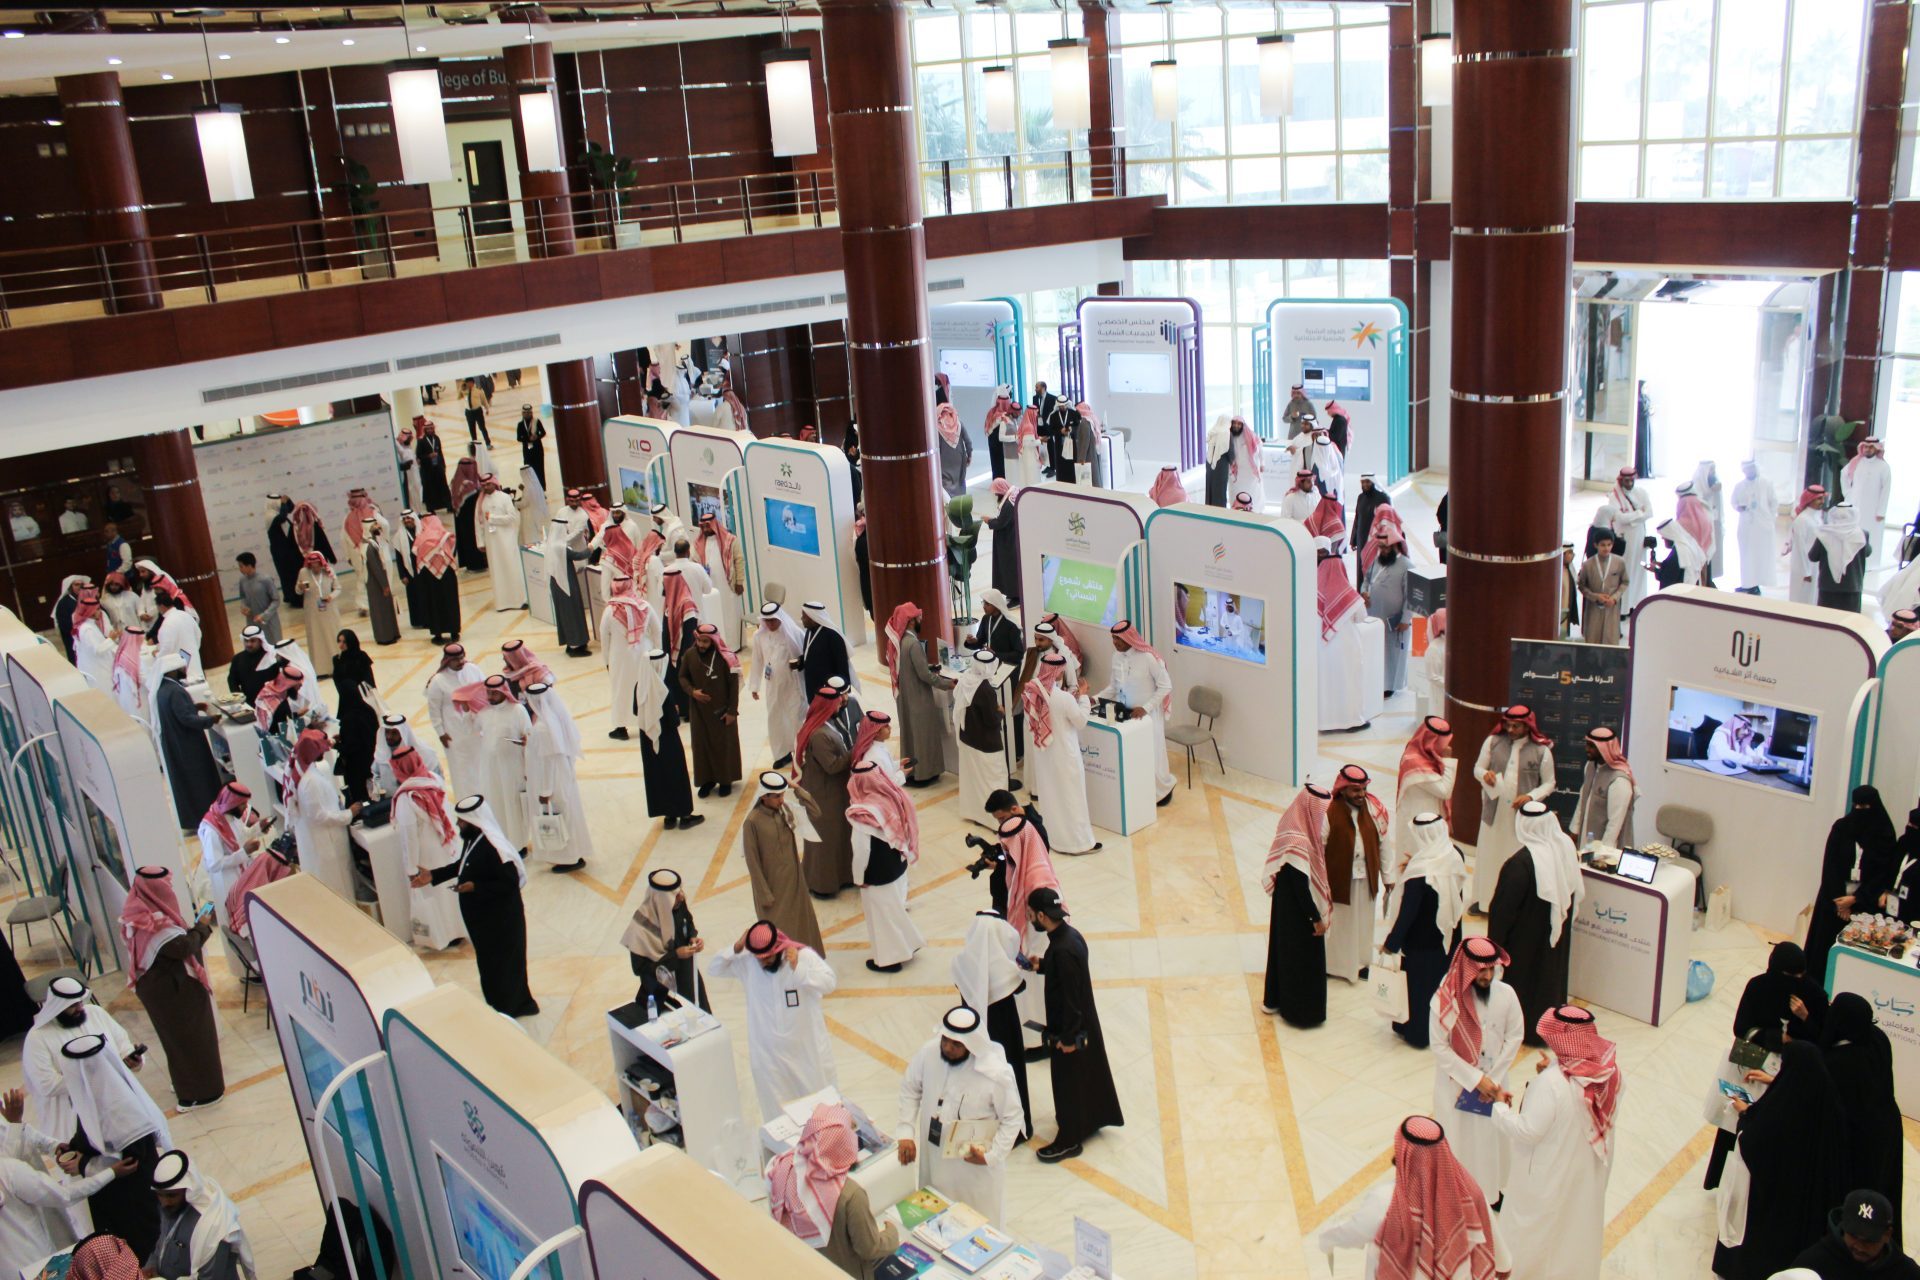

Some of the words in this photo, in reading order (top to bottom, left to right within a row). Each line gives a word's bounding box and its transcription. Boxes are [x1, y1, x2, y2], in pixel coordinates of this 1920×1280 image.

[440, 72, 469, 90] lege
[472, 69, 486, 86] of
[1560, 670, 1572, 685] 5
